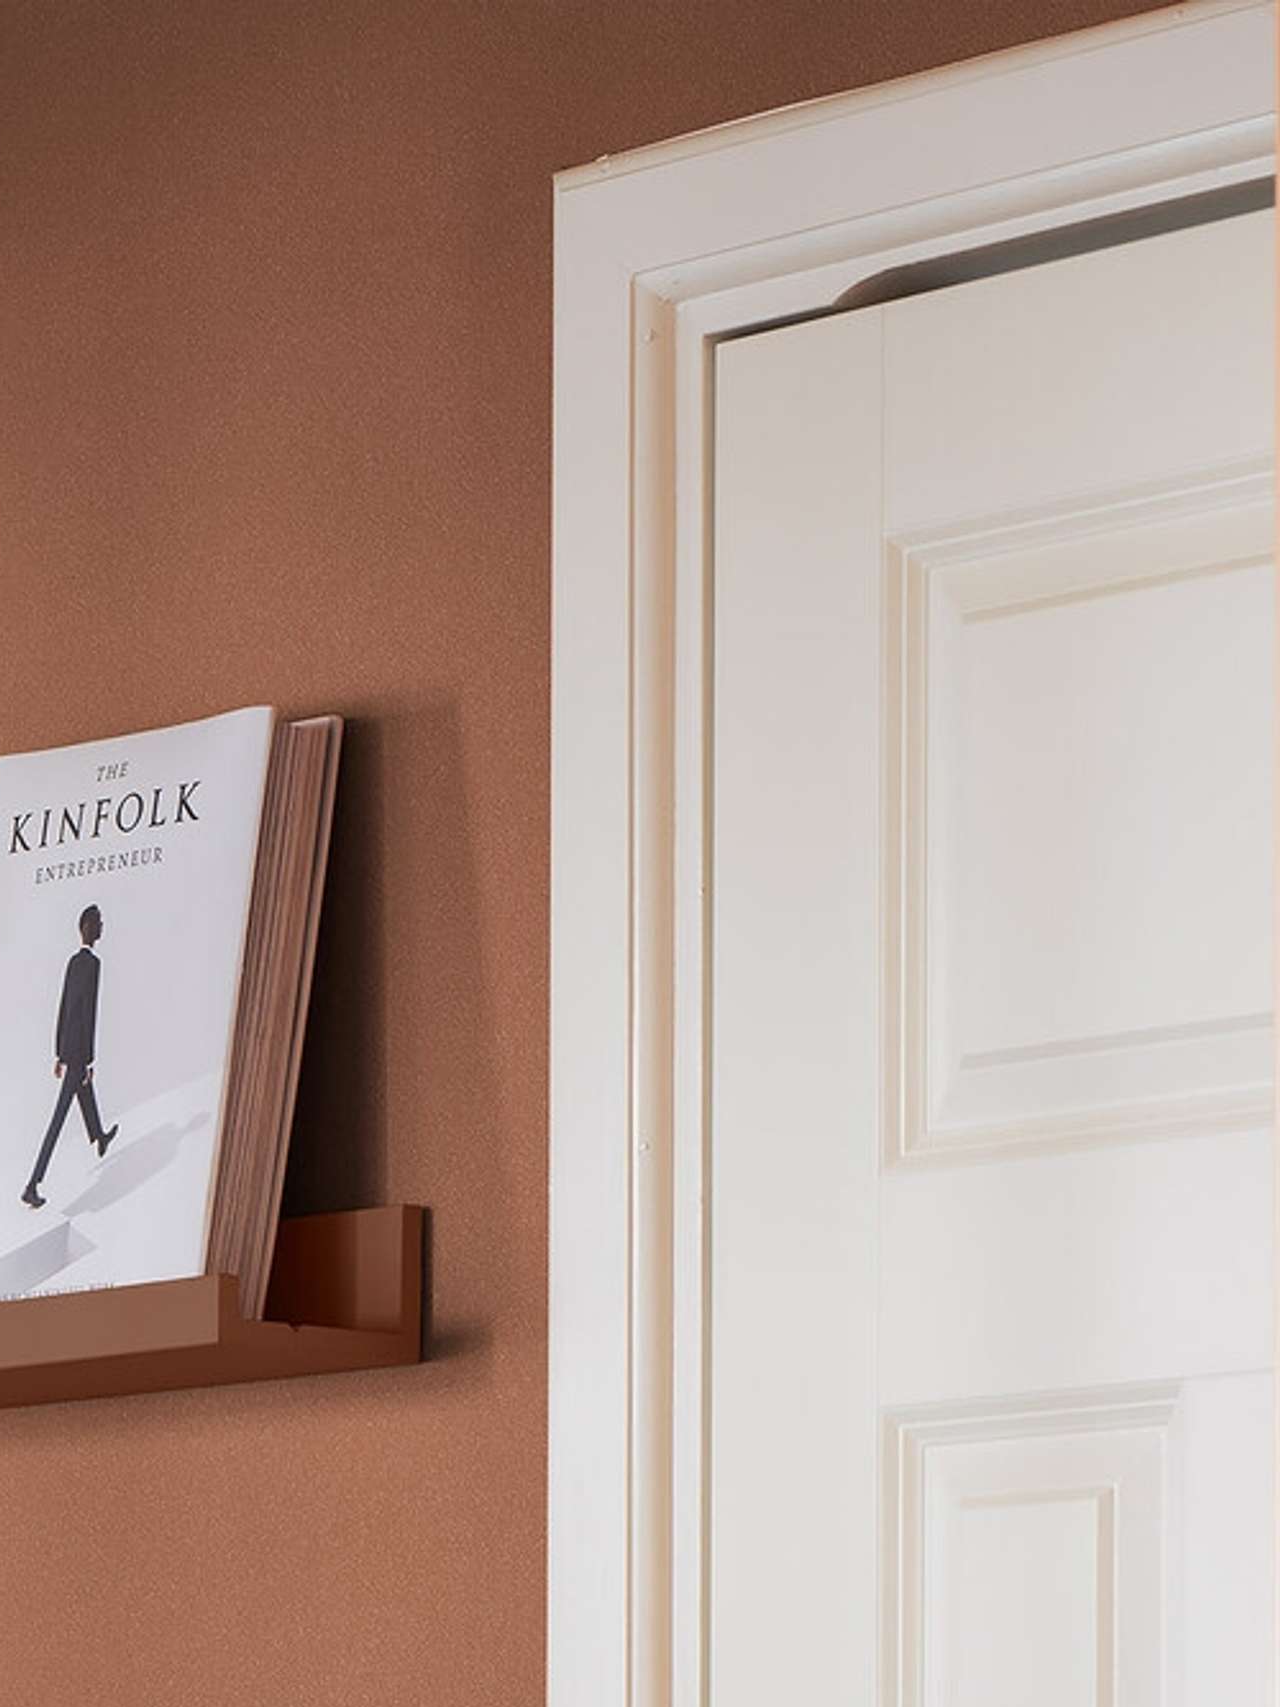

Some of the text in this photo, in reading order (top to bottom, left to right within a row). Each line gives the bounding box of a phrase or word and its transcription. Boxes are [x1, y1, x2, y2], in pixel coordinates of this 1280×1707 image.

[96, 761, 129, 782] THE
[9, 780, 202, 854] KINFOLK
[35, 847, 163, 884] ENTREPRENEUR
